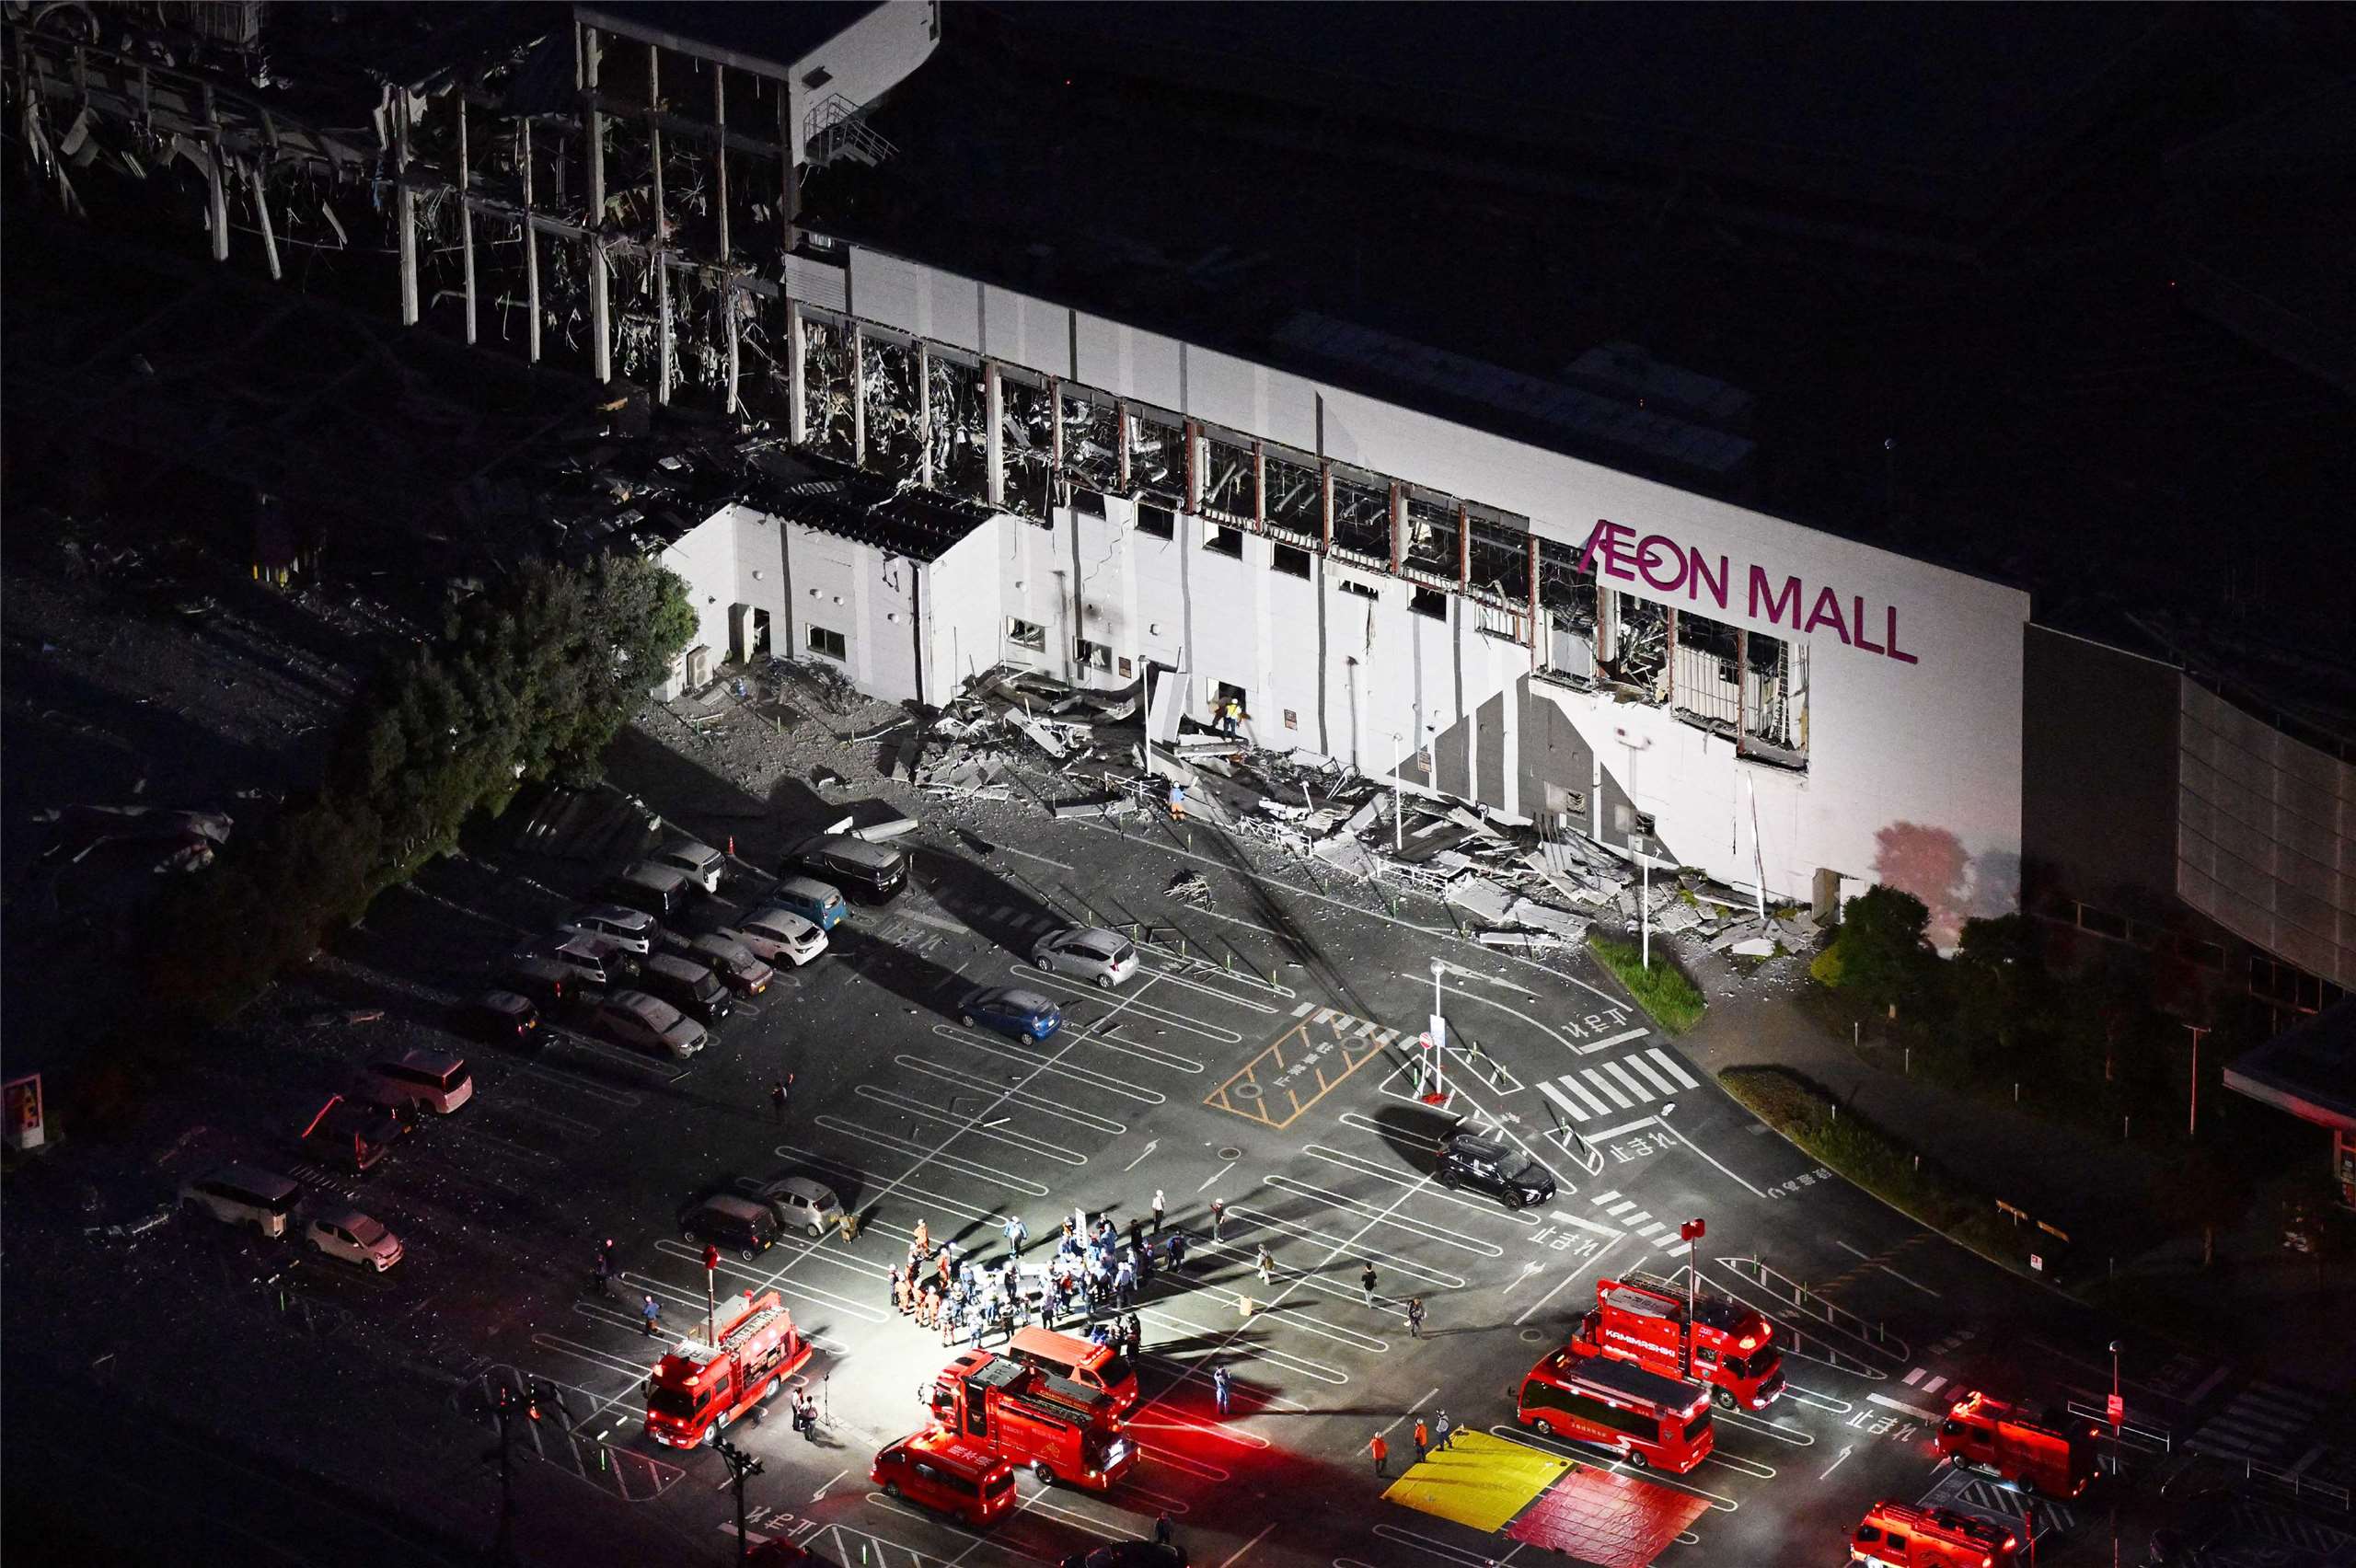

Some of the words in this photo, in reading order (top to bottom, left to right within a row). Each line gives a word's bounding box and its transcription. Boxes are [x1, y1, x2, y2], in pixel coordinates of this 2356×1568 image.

[1749, 563, 1919, 664] MALL
[1560, 1008, 1627, 1038] 止まれ
[1610, 1131, 1678, 1164] 止まれ
[1528, 1225, 1600, 1258] 止まれ
[1605, 1328, 1676, 1358] KAMIMASHIKI
[1845, 1409, 1917, 1443] 止まれ
[745, 1505, 818, 1537] 止まれ
